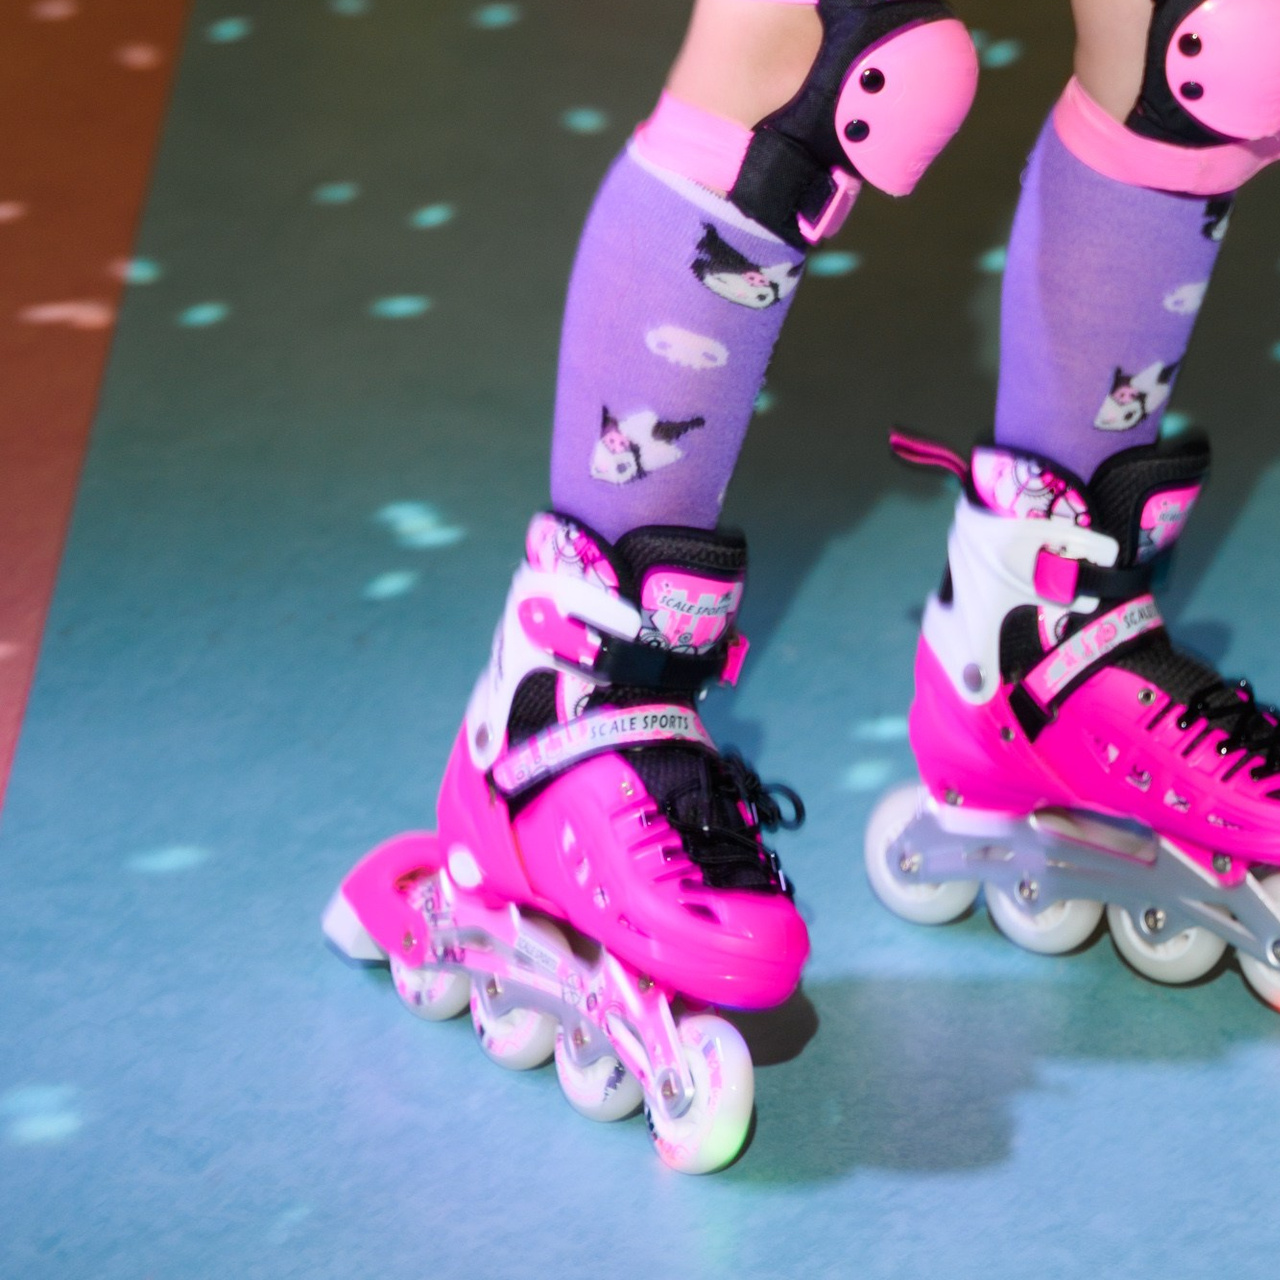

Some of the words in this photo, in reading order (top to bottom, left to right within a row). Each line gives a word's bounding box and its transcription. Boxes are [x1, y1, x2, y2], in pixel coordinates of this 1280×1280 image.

[660, 595, 695, 613] SCALE
[591, 716, 637, 739] SCALE
[642, 714, 689, 730] SPORTS
